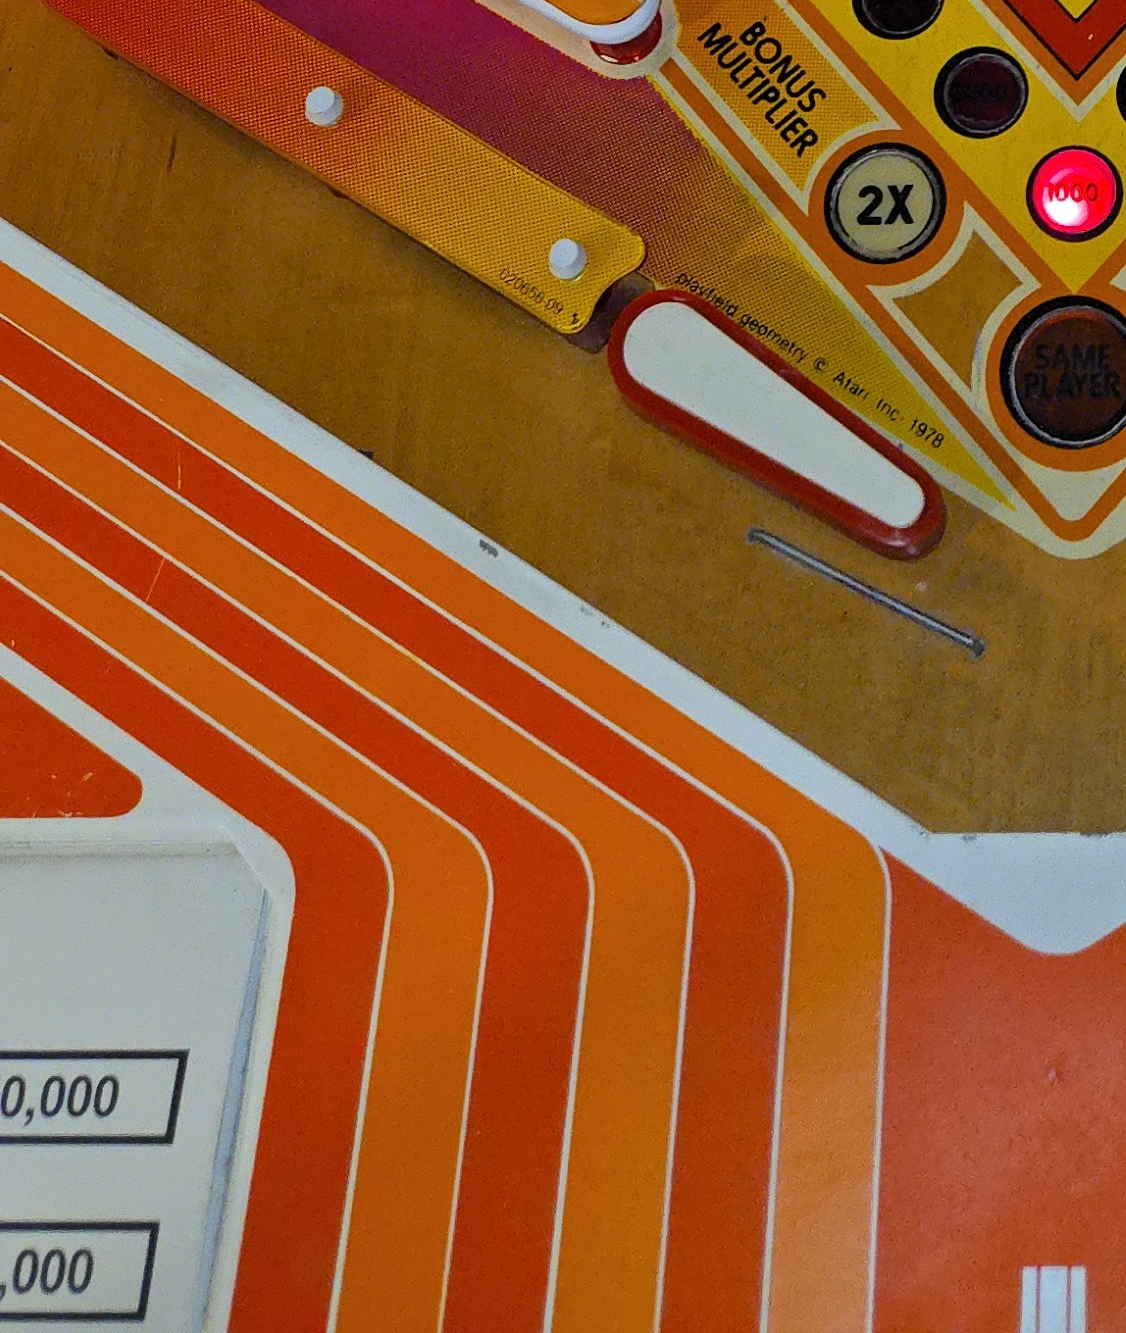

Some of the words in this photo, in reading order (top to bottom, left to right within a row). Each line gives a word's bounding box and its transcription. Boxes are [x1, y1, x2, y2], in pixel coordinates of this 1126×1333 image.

[697, 22, 820, 159] MULTIPLIER
[738, 20, 827, 114] BONUS
[856, 184, 915, 226] 2X
[1046, 181, 1099, 203] 1000
[1035, 343, 1111, 371] SAME
[740, 313, 810, 365] geometry
[832, 370, 869, 400] Atari
[909, 417, 945, 449] 1978
[1023, 372, 1121, 398] PLAYER
[1, 1075, 120, 1127] 0,000
